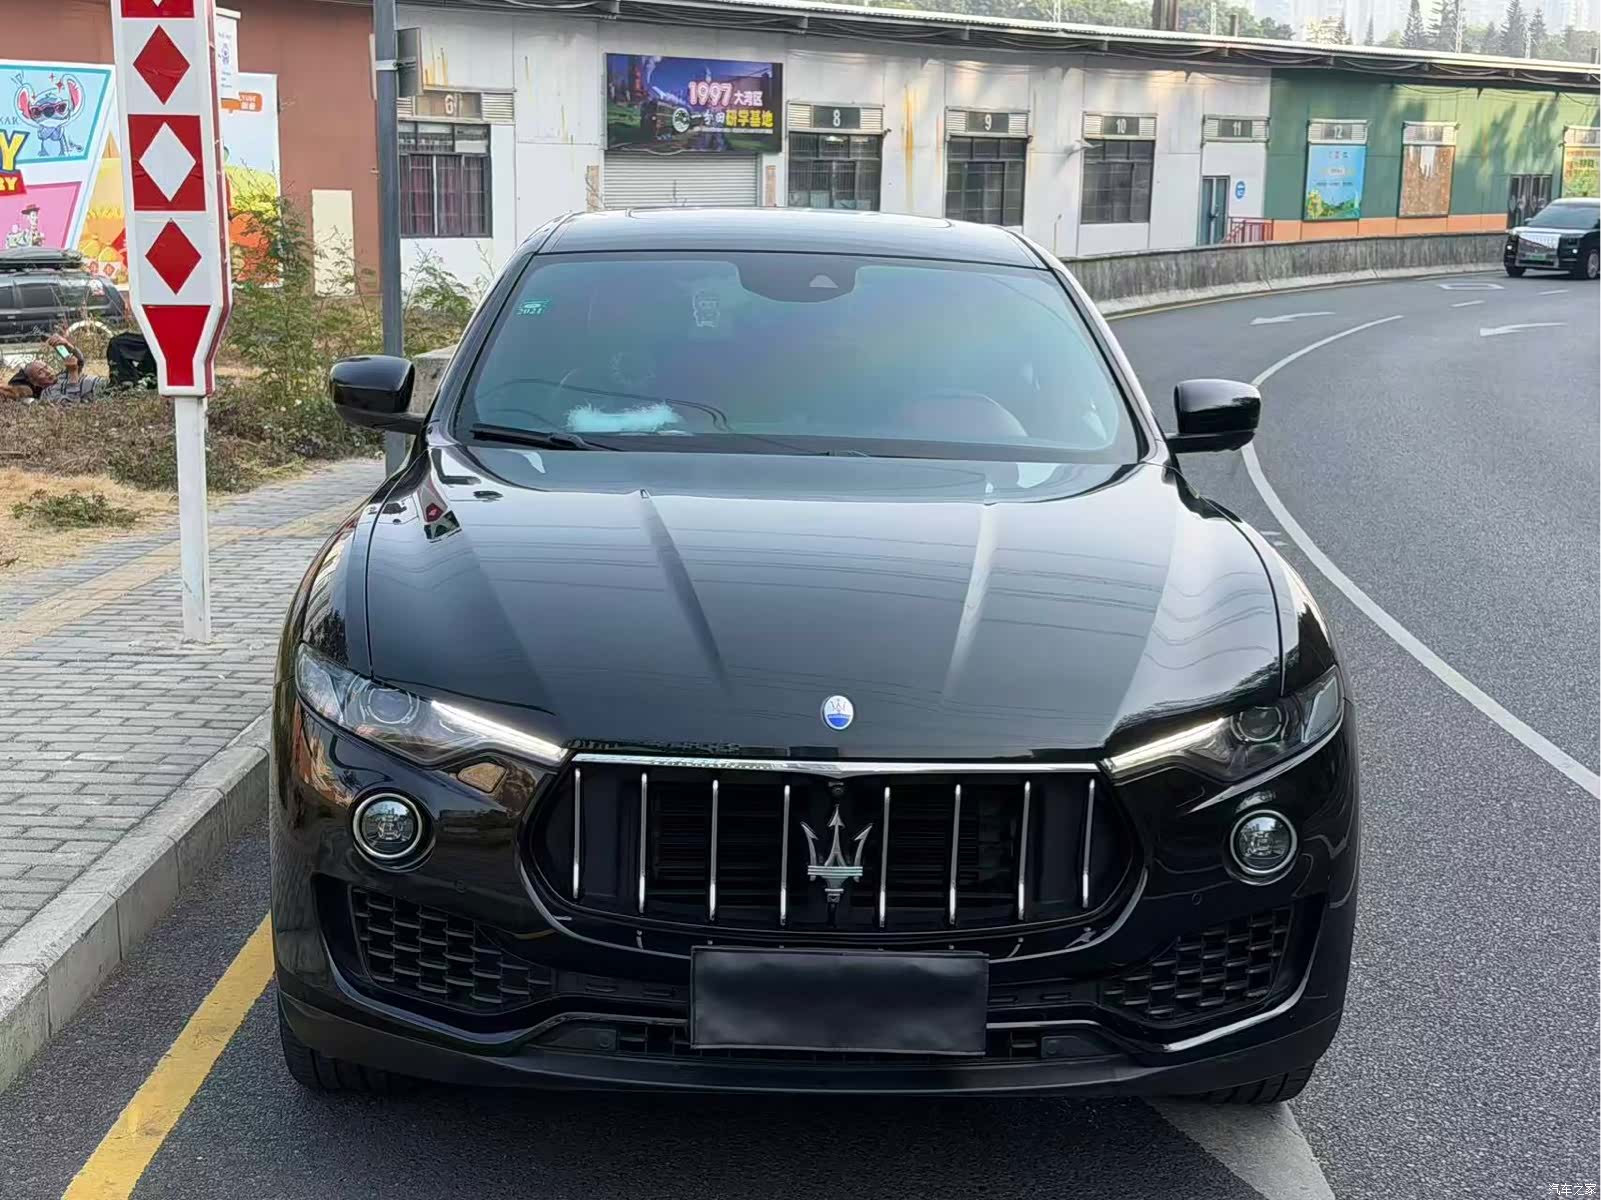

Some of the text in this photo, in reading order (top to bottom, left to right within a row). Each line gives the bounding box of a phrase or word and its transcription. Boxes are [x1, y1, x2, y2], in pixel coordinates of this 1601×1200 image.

[688, 81, 732, 106] 1997
[833, 109, 841, 127] 8
[985, 114, 992, 131] 9
[1116, 118, 1126, 134] 10
[1233, 121, 1241, 136] 11
[1334, 125, 1343, 139] 12
